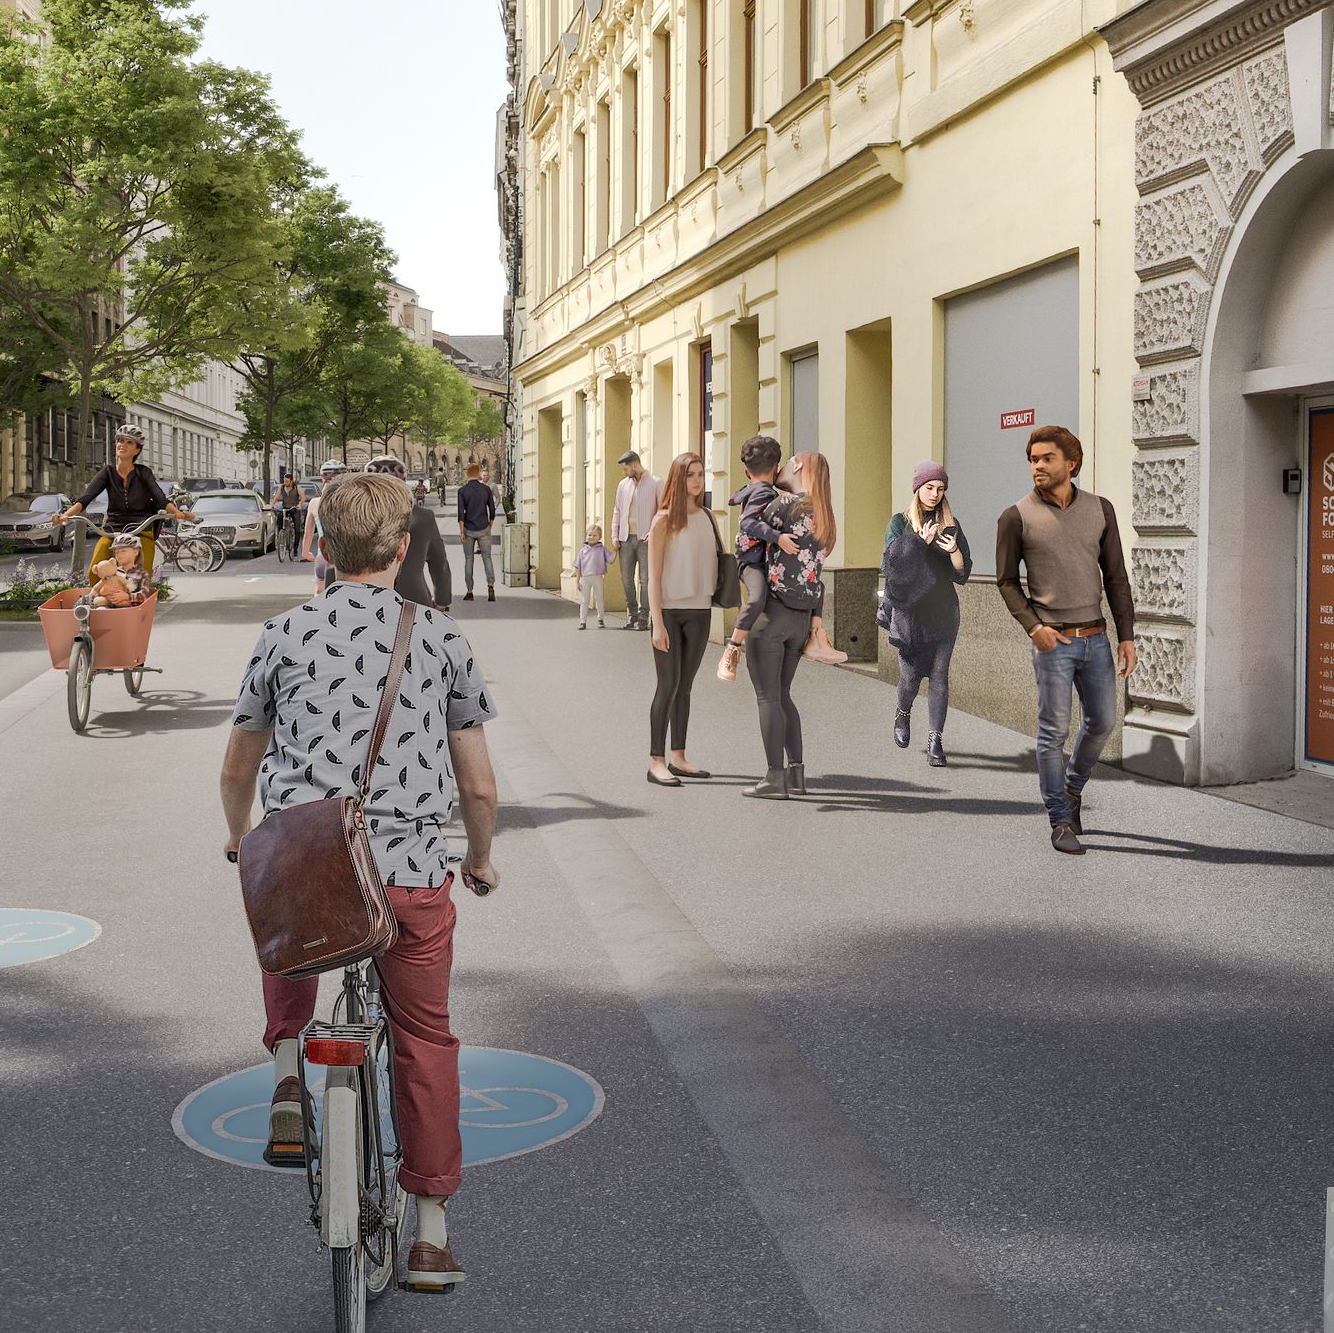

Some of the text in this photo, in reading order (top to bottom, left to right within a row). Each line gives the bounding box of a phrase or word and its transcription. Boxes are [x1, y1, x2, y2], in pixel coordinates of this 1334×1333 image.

[1002, 411, 1033, 426] VERKAUFT
[1320, 604, 1333, 614] HIER
[1322, 699, 1331, 707] mit
